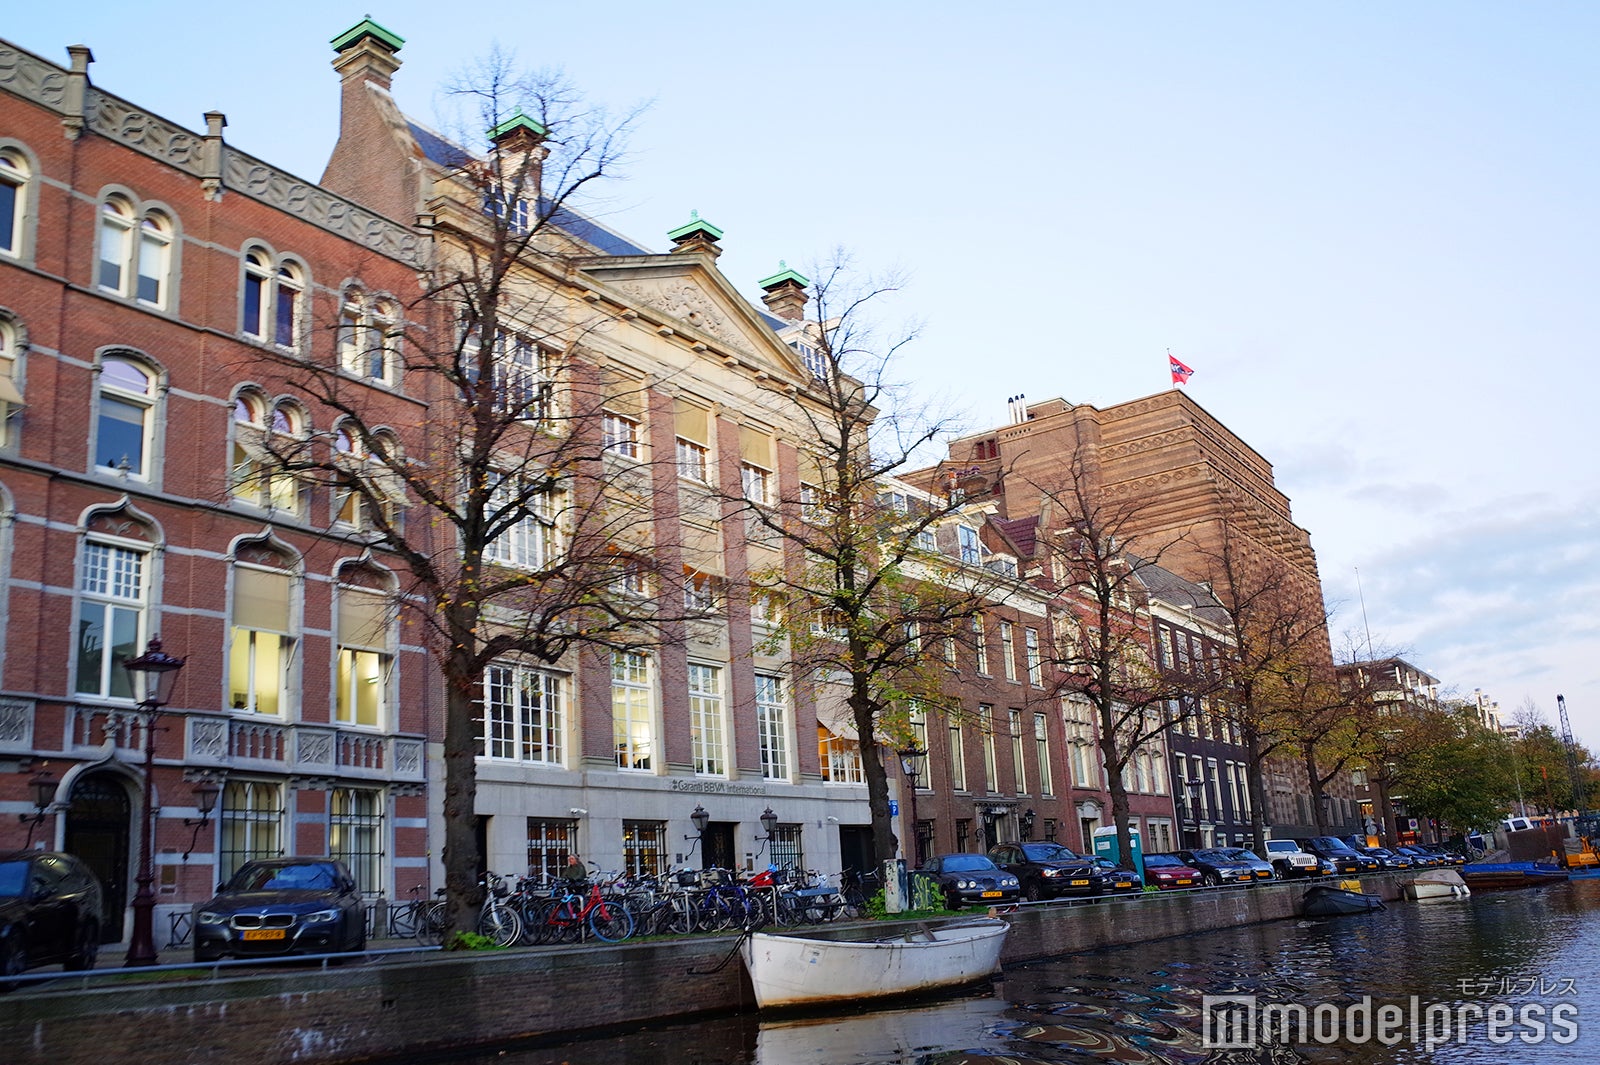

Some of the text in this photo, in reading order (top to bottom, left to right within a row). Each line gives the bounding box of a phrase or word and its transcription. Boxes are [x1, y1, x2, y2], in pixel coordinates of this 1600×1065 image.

[678, 780, 767, 795] Garanti BBVA International
